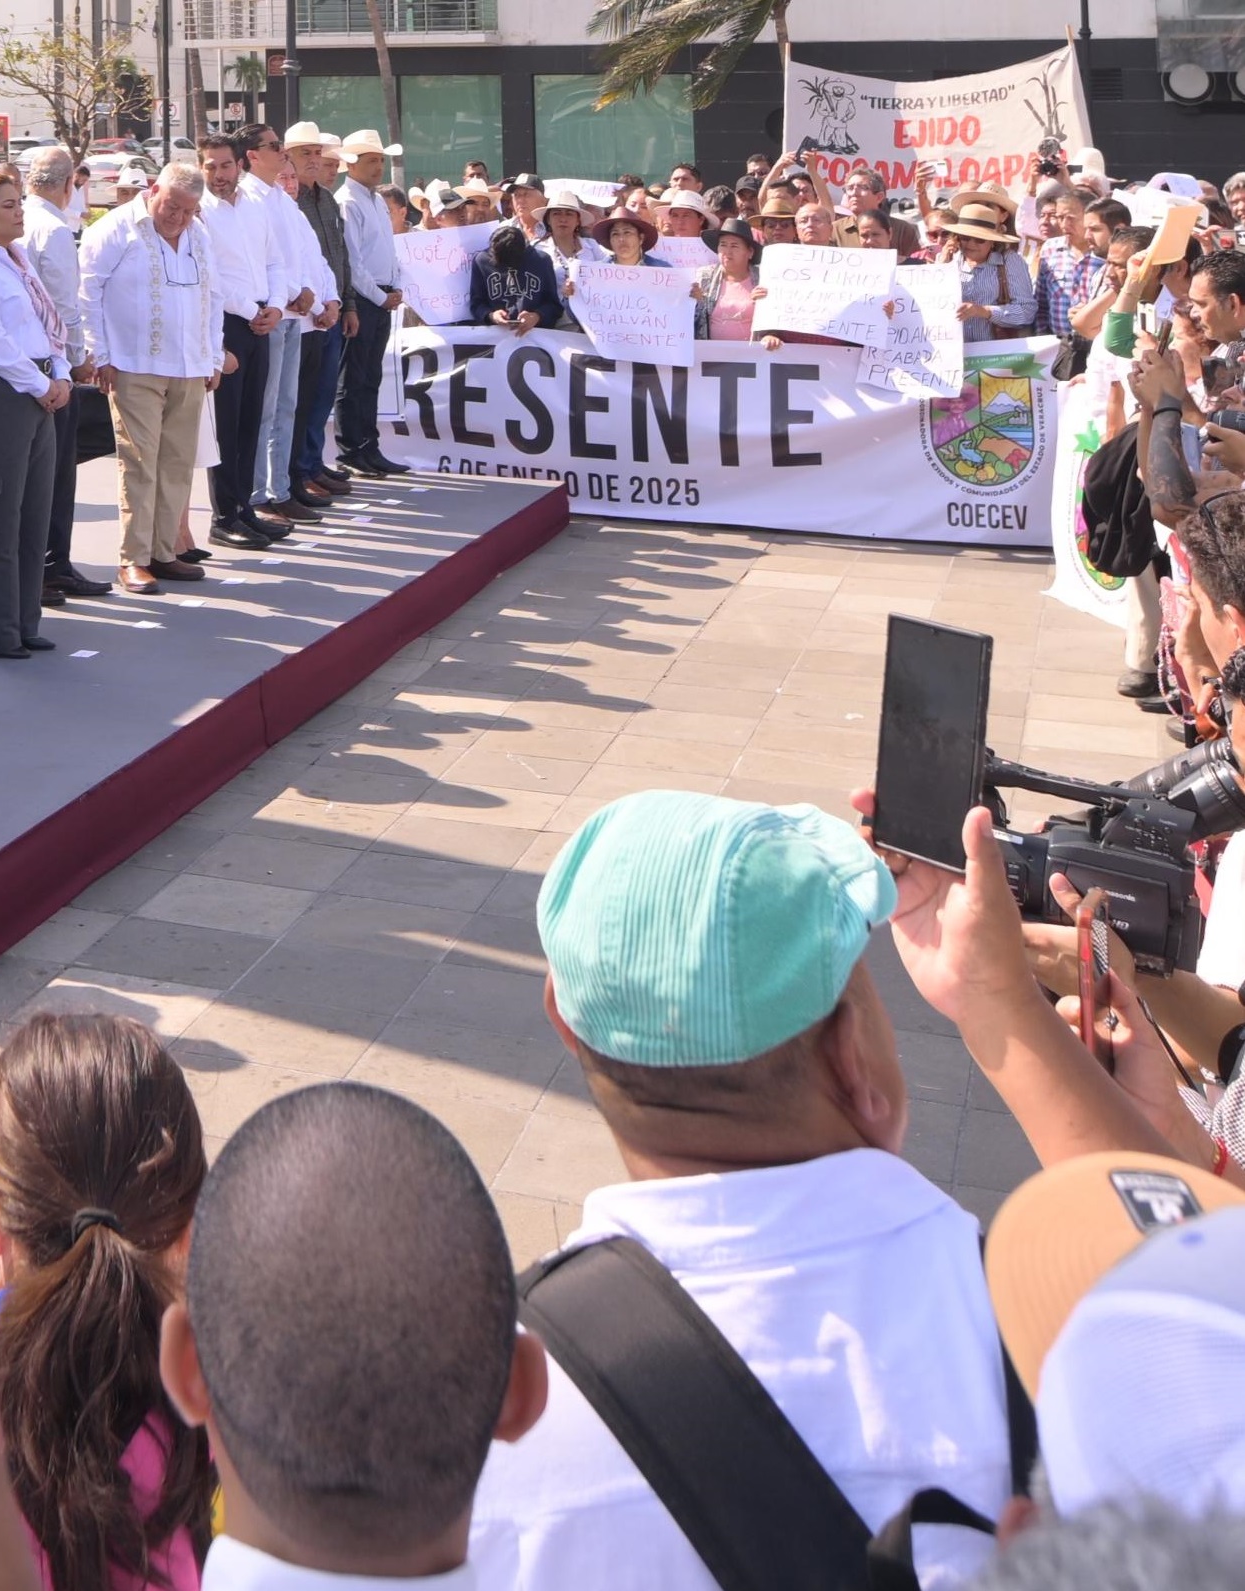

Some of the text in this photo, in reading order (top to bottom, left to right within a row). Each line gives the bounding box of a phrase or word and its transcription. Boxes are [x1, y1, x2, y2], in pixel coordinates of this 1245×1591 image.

[928, 96, 937, 109] Y
[894, 115, 981, 149] EJIDO
[486, 269, 541, 301] GAP
[653, 271, 680, 288] DE
[391, 343, 823, 469] RESENTE
[1036, 386, 1045, 431] VERACRUZ
[588, 472, 620, 503] DE
[630, 476, 700, 507] 2025
[947, 501, 1028, 530] COECEV
